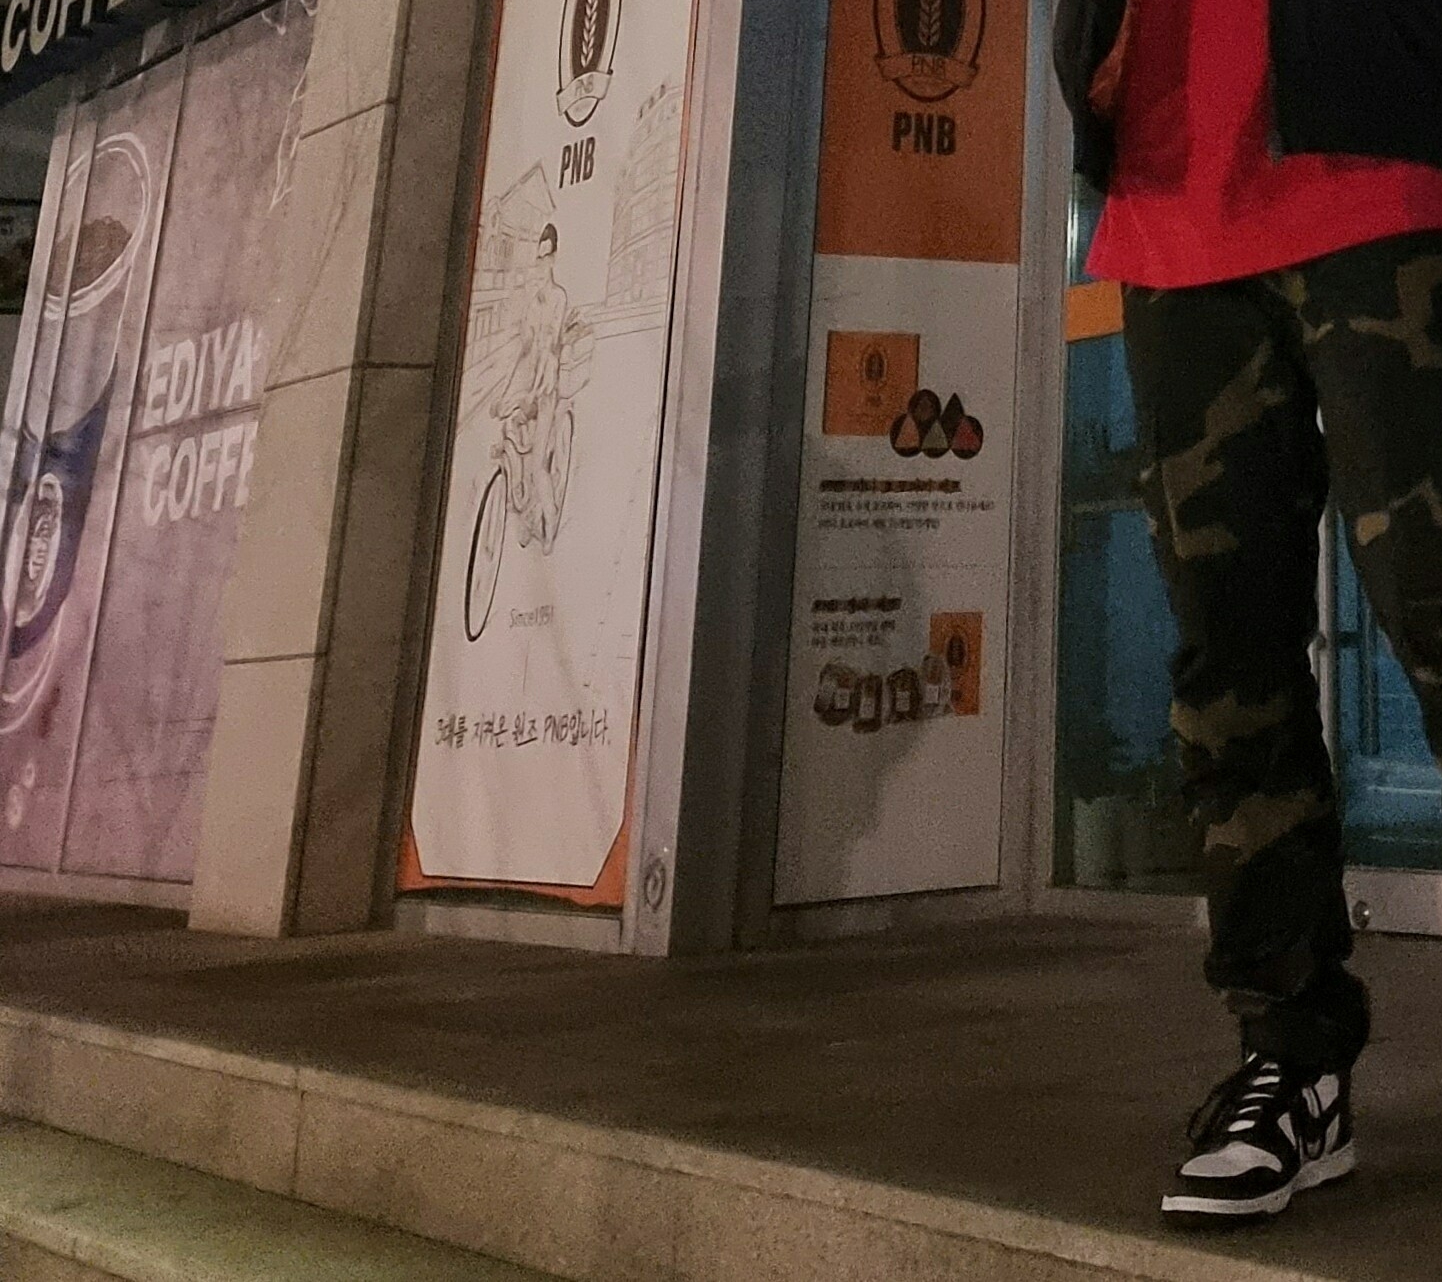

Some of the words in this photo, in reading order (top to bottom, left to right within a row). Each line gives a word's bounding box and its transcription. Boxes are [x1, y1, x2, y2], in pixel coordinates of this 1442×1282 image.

[892, 111, 956, 156] PNB
[559, 136, 596, 189] PNB
[143, 319, 254, 430] EDIYA
[512, 711, 539, 747] 원조
